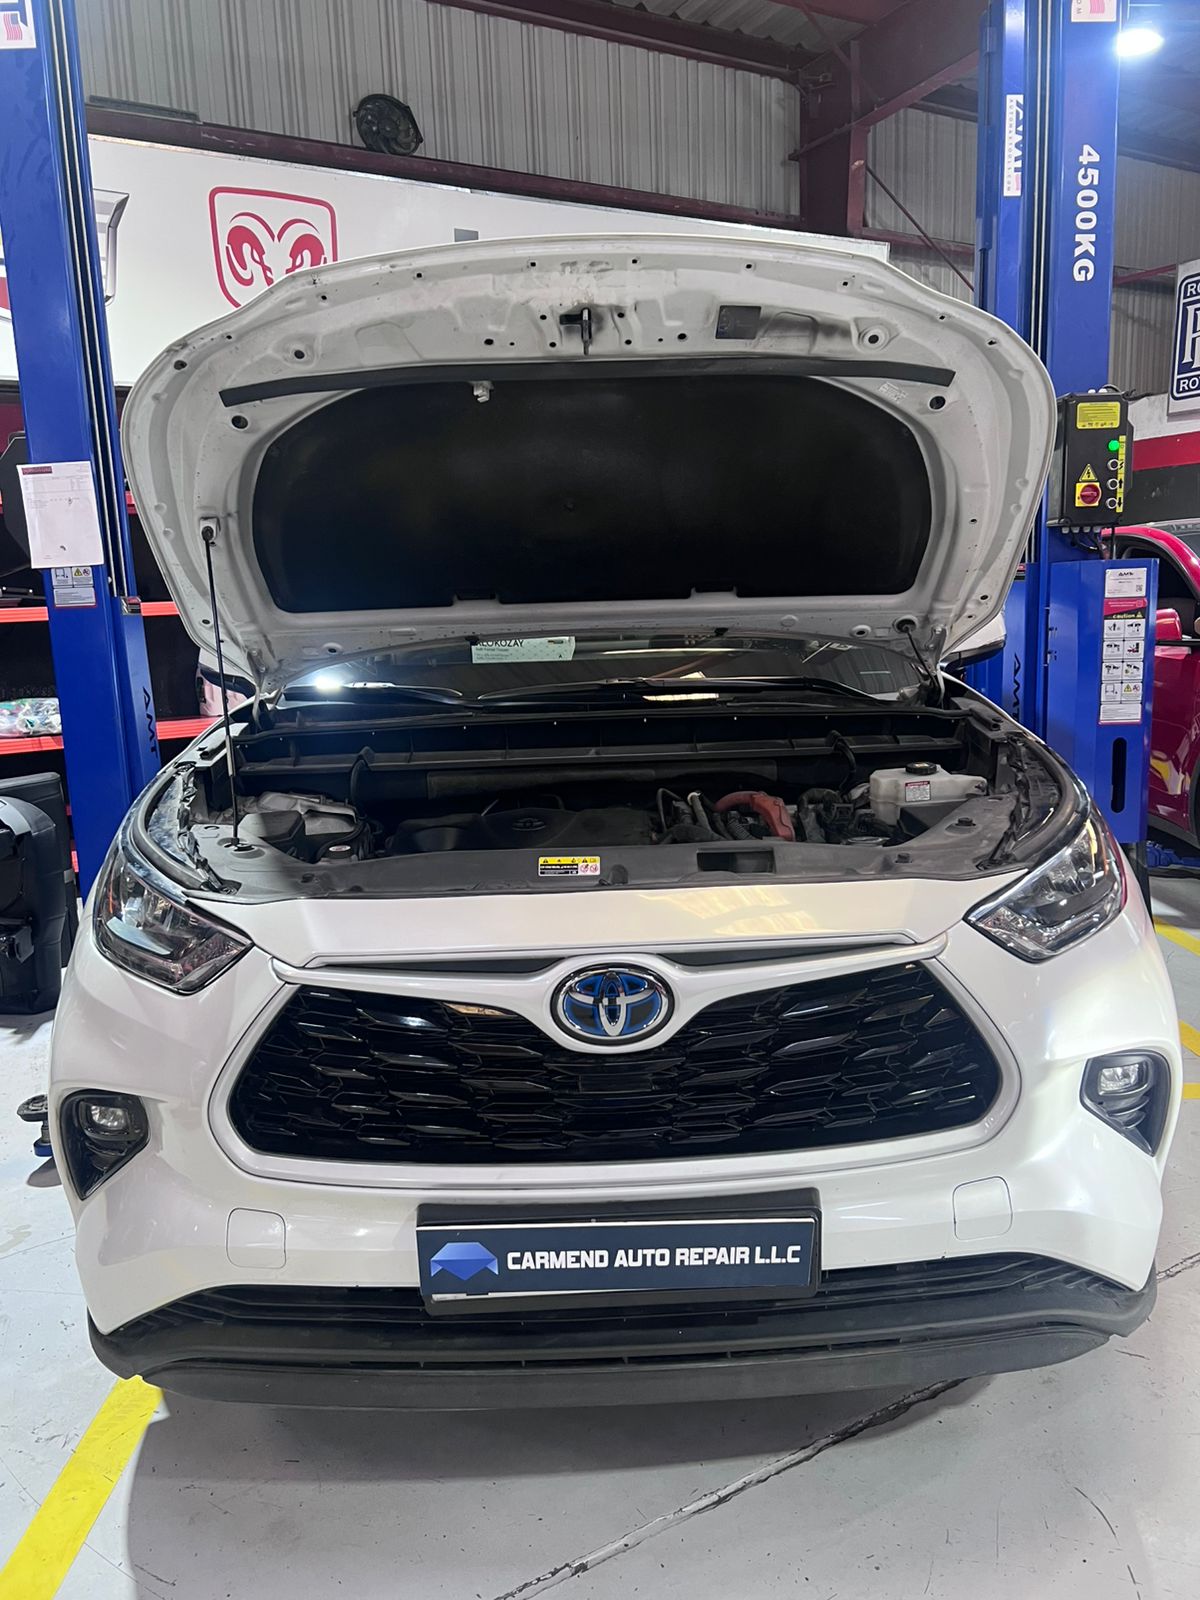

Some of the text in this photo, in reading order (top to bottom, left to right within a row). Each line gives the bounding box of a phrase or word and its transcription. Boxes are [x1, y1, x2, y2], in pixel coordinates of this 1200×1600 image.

[1073, 144, 1100, 282] 4500KG
[507, 1245, 801, 1270] CARMEND AUTO REPAIR L.L.C
